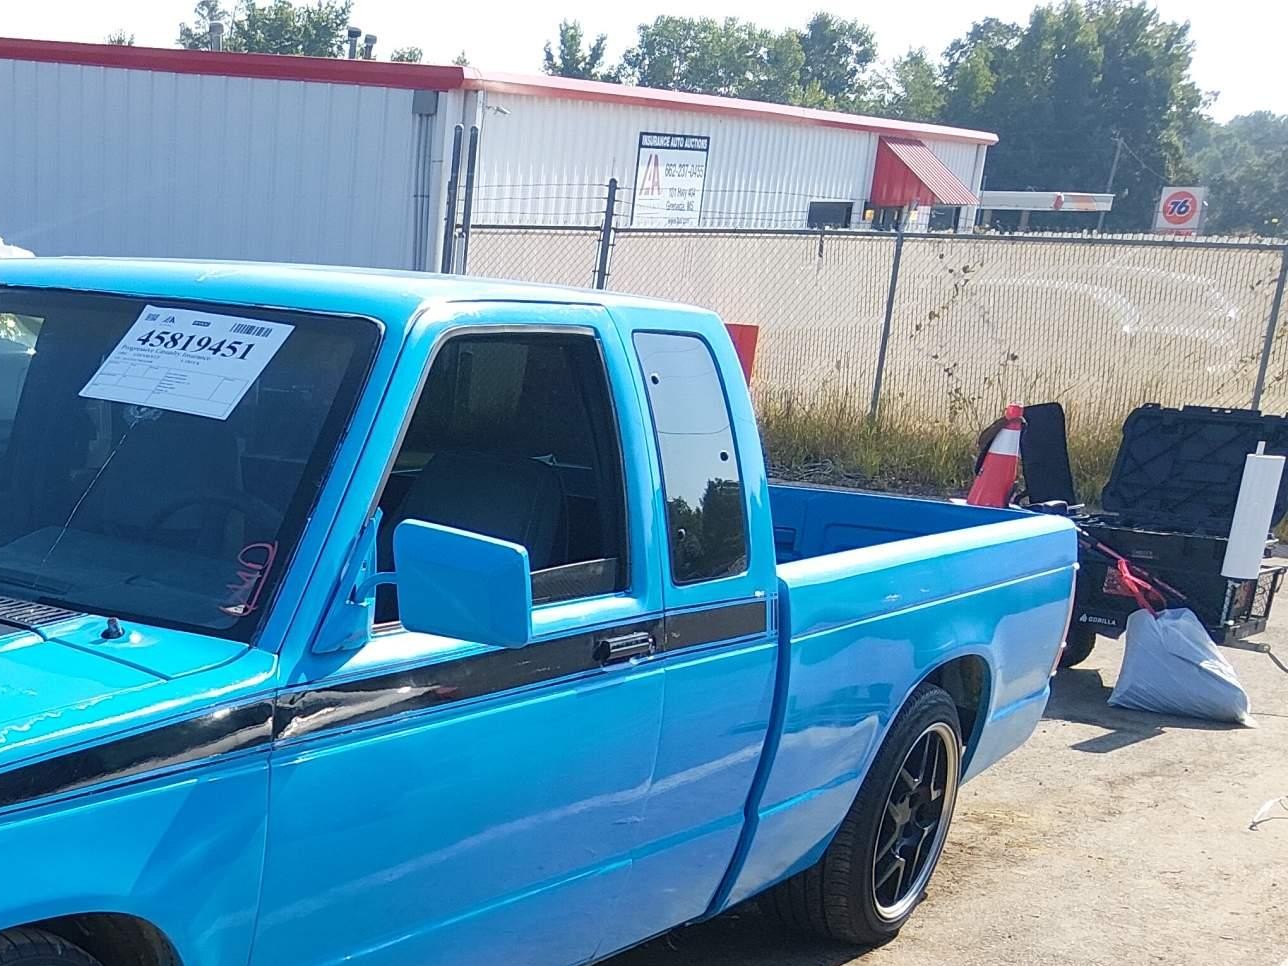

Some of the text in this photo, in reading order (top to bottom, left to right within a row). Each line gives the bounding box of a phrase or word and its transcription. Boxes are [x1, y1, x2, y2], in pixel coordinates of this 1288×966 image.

[642, 135, 708, 149] INSURANCE AUTO AUCTIONS
[1166, 198, 1192, 217] 76
[137, 329, 256, 361] 45819451
[1088, 616, 1117, 625] GORILLA
